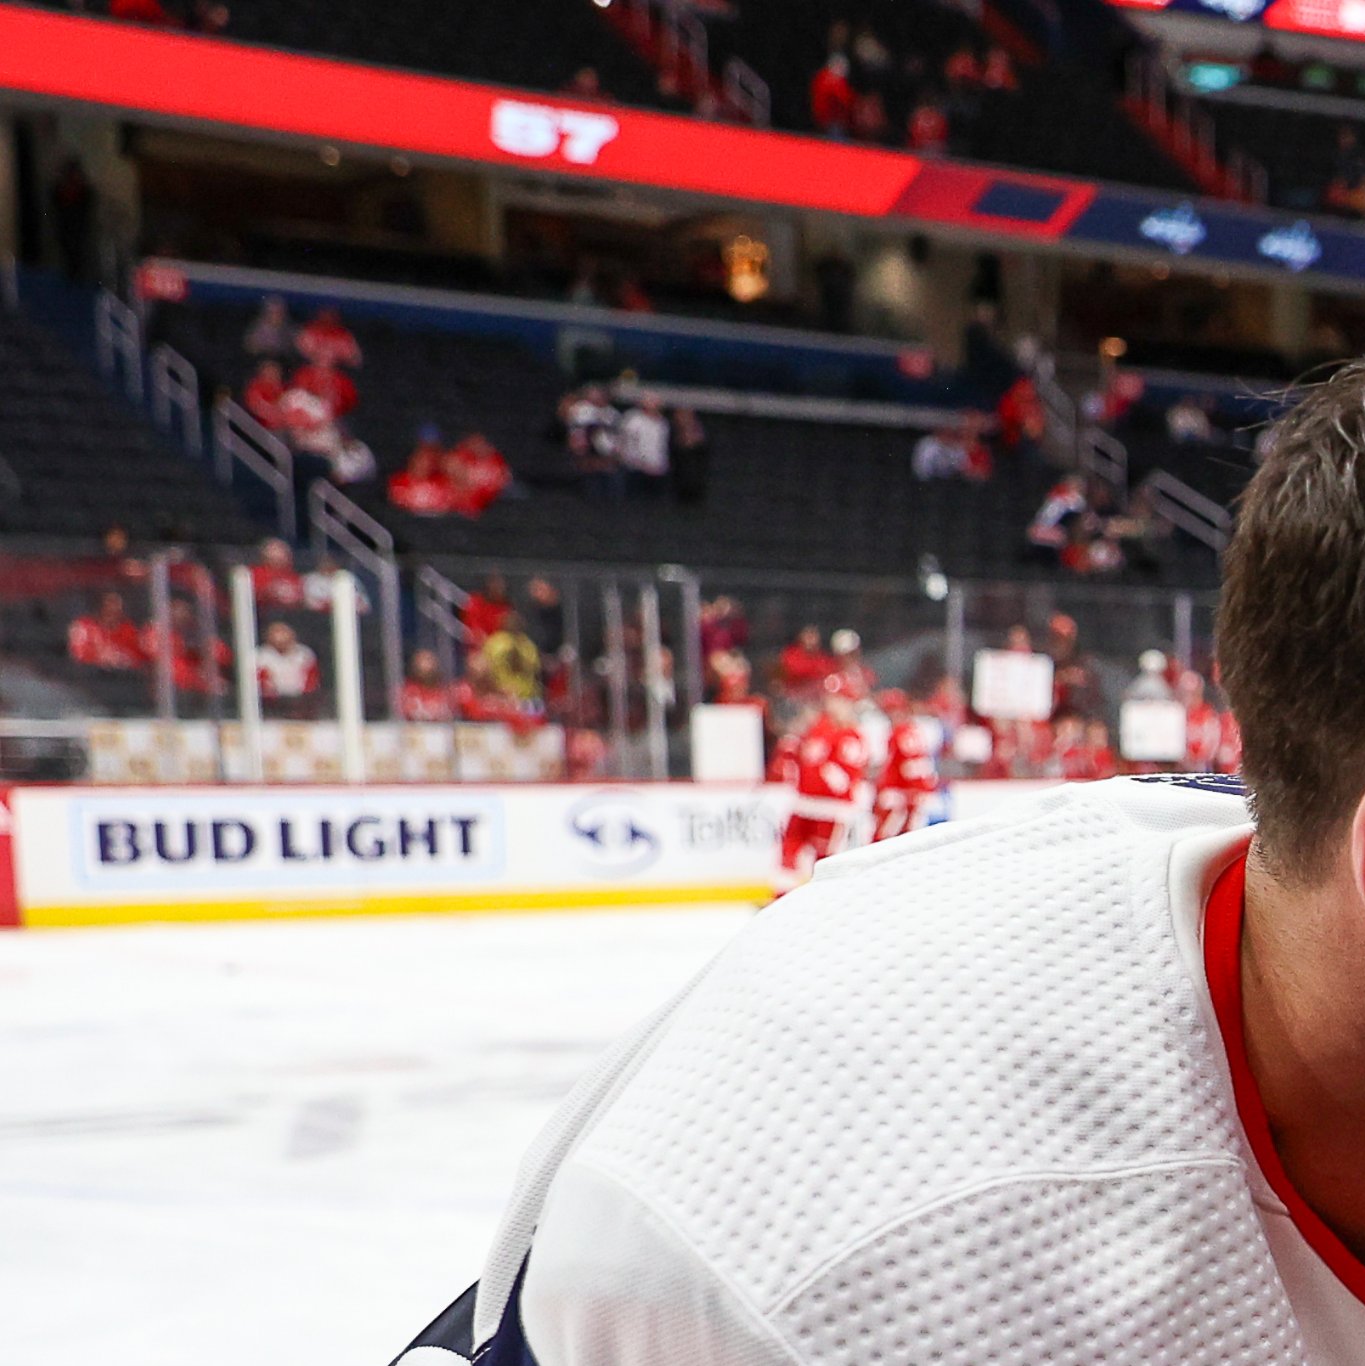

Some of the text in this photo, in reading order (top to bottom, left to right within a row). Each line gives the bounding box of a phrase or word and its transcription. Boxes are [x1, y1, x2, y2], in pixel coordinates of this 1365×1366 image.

[490, 99, 620, 164] 57
[98, 815, 480, 865] BUD LIGHT
